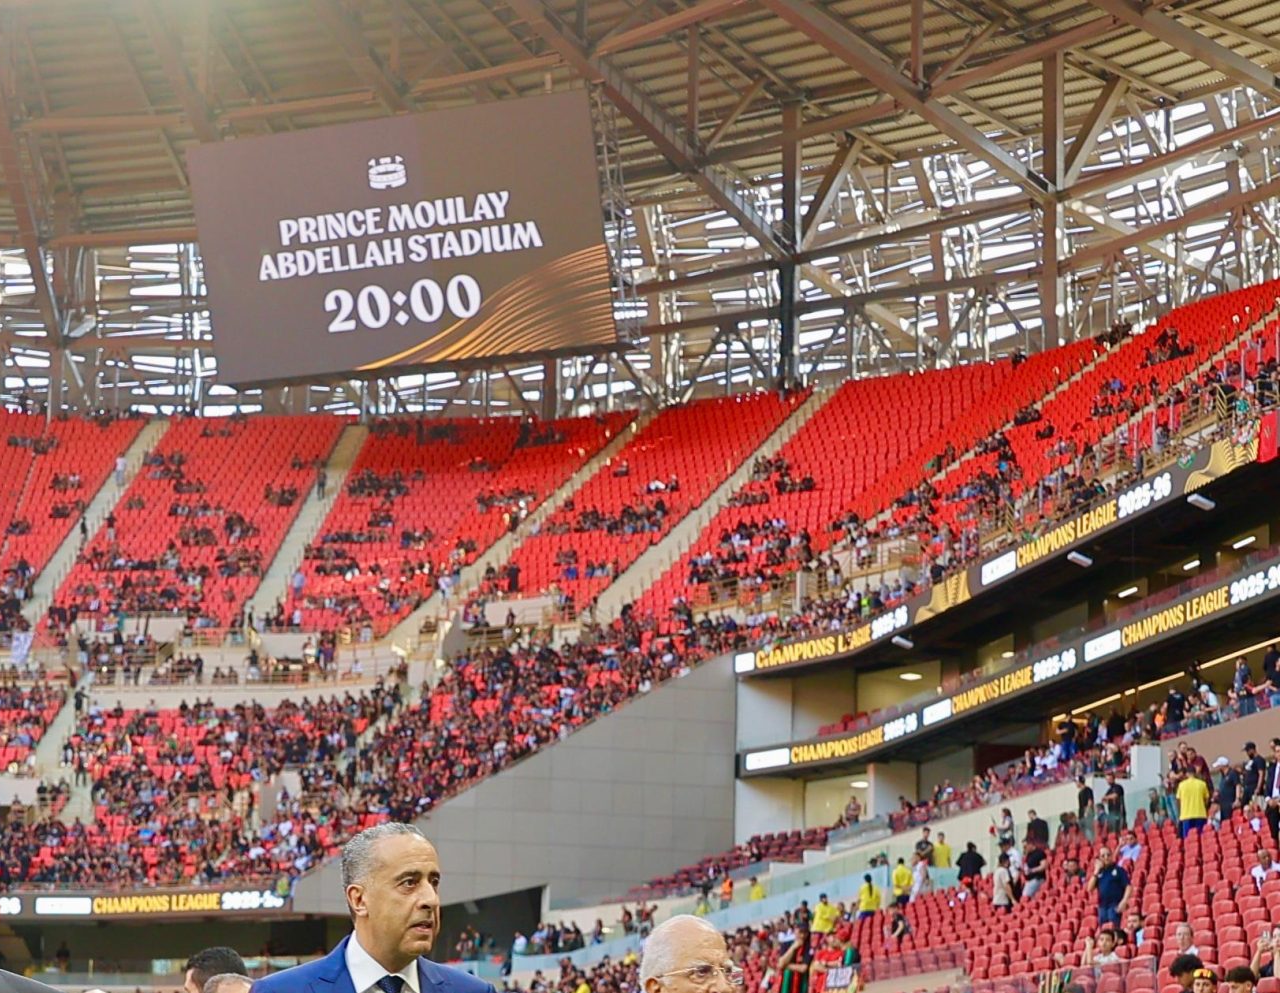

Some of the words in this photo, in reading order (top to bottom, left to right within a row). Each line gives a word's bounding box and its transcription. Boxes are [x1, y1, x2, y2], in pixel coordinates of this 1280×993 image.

[279, 207, 384, 246] PRINCE
[388, 191, 509, 232] MOULAY
[259, 237, 404, 281] ABDELLAH
[408, 221, 543, 262] STADIUM
[324, 274, 482, 333] 20:00
[1016, 522, 1075, 568] CHAMPIONS
[1076, 499, 1117, 538] LEAGUE
[1118, 472, 1172, 518] 2025-26
[1122, 606, 1185, 647] CHAMPIONS
[1186, 586, 1229, 620] LEAGUE
[952, 679, 999, 714] CHAMPIONS
[1000, 665, 1032, 695] LEAGUE
[790, 737, 858, 764] CHAMPIONS
[858, 726, 884, 751] LEAGUE
[93, 895, 170, 914] CHAMPIONS
[172, 893, 221, 912] LEAGUE
